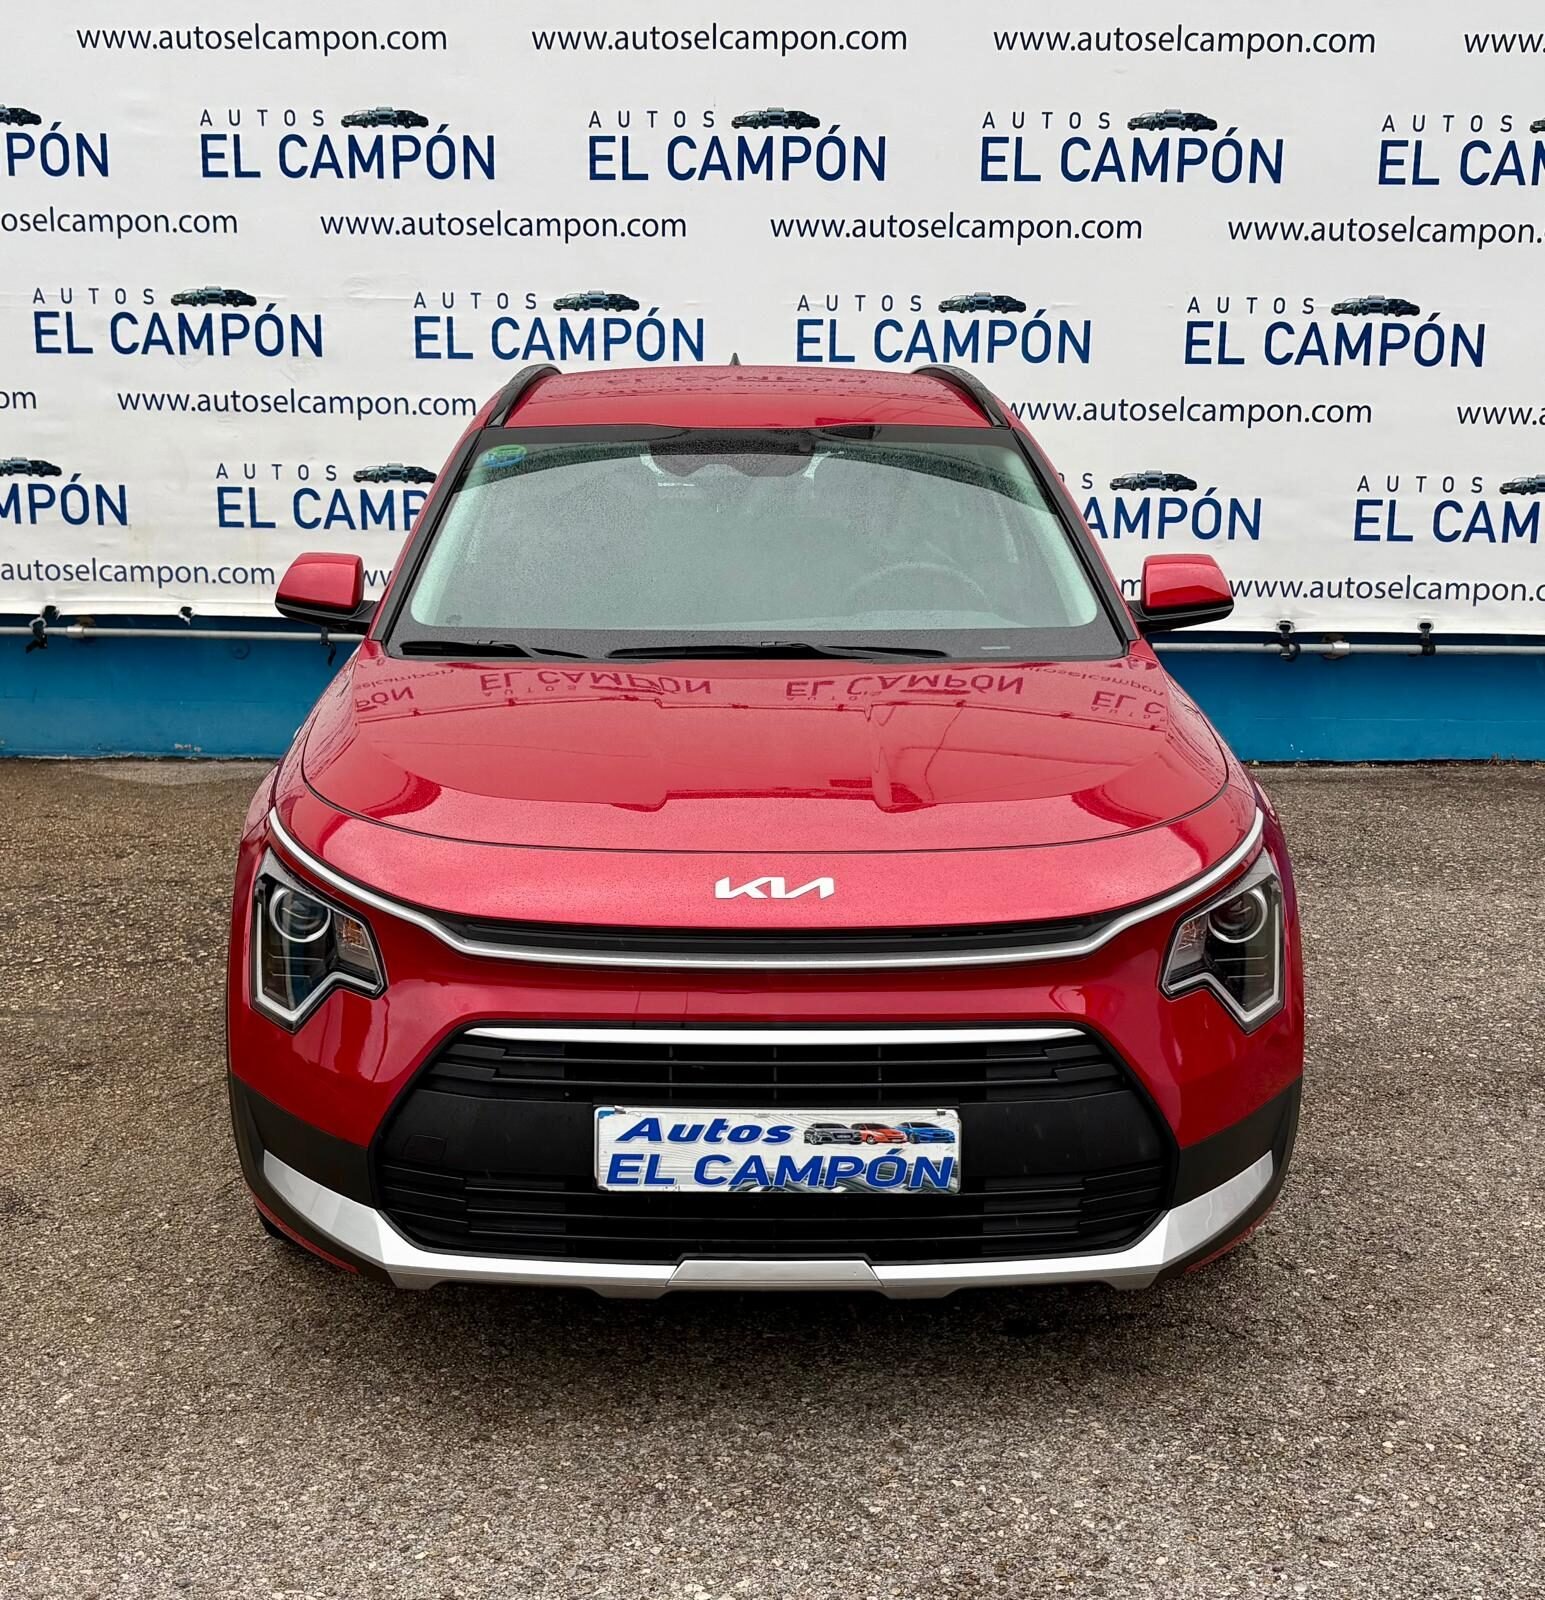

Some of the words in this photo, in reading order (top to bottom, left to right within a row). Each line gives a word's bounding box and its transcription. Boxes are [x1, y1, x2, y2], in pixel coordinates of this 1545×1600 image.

[77, 23, 446, 56] www.autoselcampon.com
[532, 23, 906, 56] www.autoselcampon.com
[994, 24, 1375, 59] www.autoselcampon.com
[200, 109, 324, 126] AUTOS
[589, 111, 714, 128] AUTOS
[982, 112, 1110, 129] AUTOS
[1382, 115, 1512, 132] AUTOS
[201, 134, 261, 178] EL
[279, 123, 495, 180] CAMPÓN
[589, 136, 648, 180] EL
[668, 125, 885, 181] CAMPÓN
[981, 137, 1041, 181] EL
[1061, 126, 1283, 184] CAMPÓN
[1379, 140, 1439, 185] EL
[2, 206, 237, 239] oselcampon.com
[320, 210, 686, 244] www.autoselcampon.com
[771, 212, 1141, 245] www.autoselcampon.com
[33, 288, 154, 305] AUTOS
[414, 292, 536, 309] AUTOS
[797, 295, 921, 311] AUTOS
[1187, 297, 1314, 314] AUTOS
[34, 311, 93, 354] EL
[111, 302, 322, 357] CAMPÓN
[415, 316, 473, 359] EL
[492, 306, 703, 361] CAMPÓN
[797, 319, 855, 362] EL
[874, 309, 1091, 367] CAMPÓN
[1185, 321, 1244, 365] EL
[1265, 312, 1485, 367] CAMPÓN
[118, 387, 476, 421] www.autoselcampon.com
[216, 463, 336, 481] AUTOS
[1357, 475, 1482, 493] AUTOS
[217, 487, 276, 528] EL
[1354, 499, 1413, 542] EL
[1433, 500, 1540, 543] CAM
[1, 558, 274, 588] autoselcampon.com
[614, 1117, 798, 1145] Autos
[606, 1153, 677, 1188] EL
[693, 1148, 955, 1189] CAMPÓN
